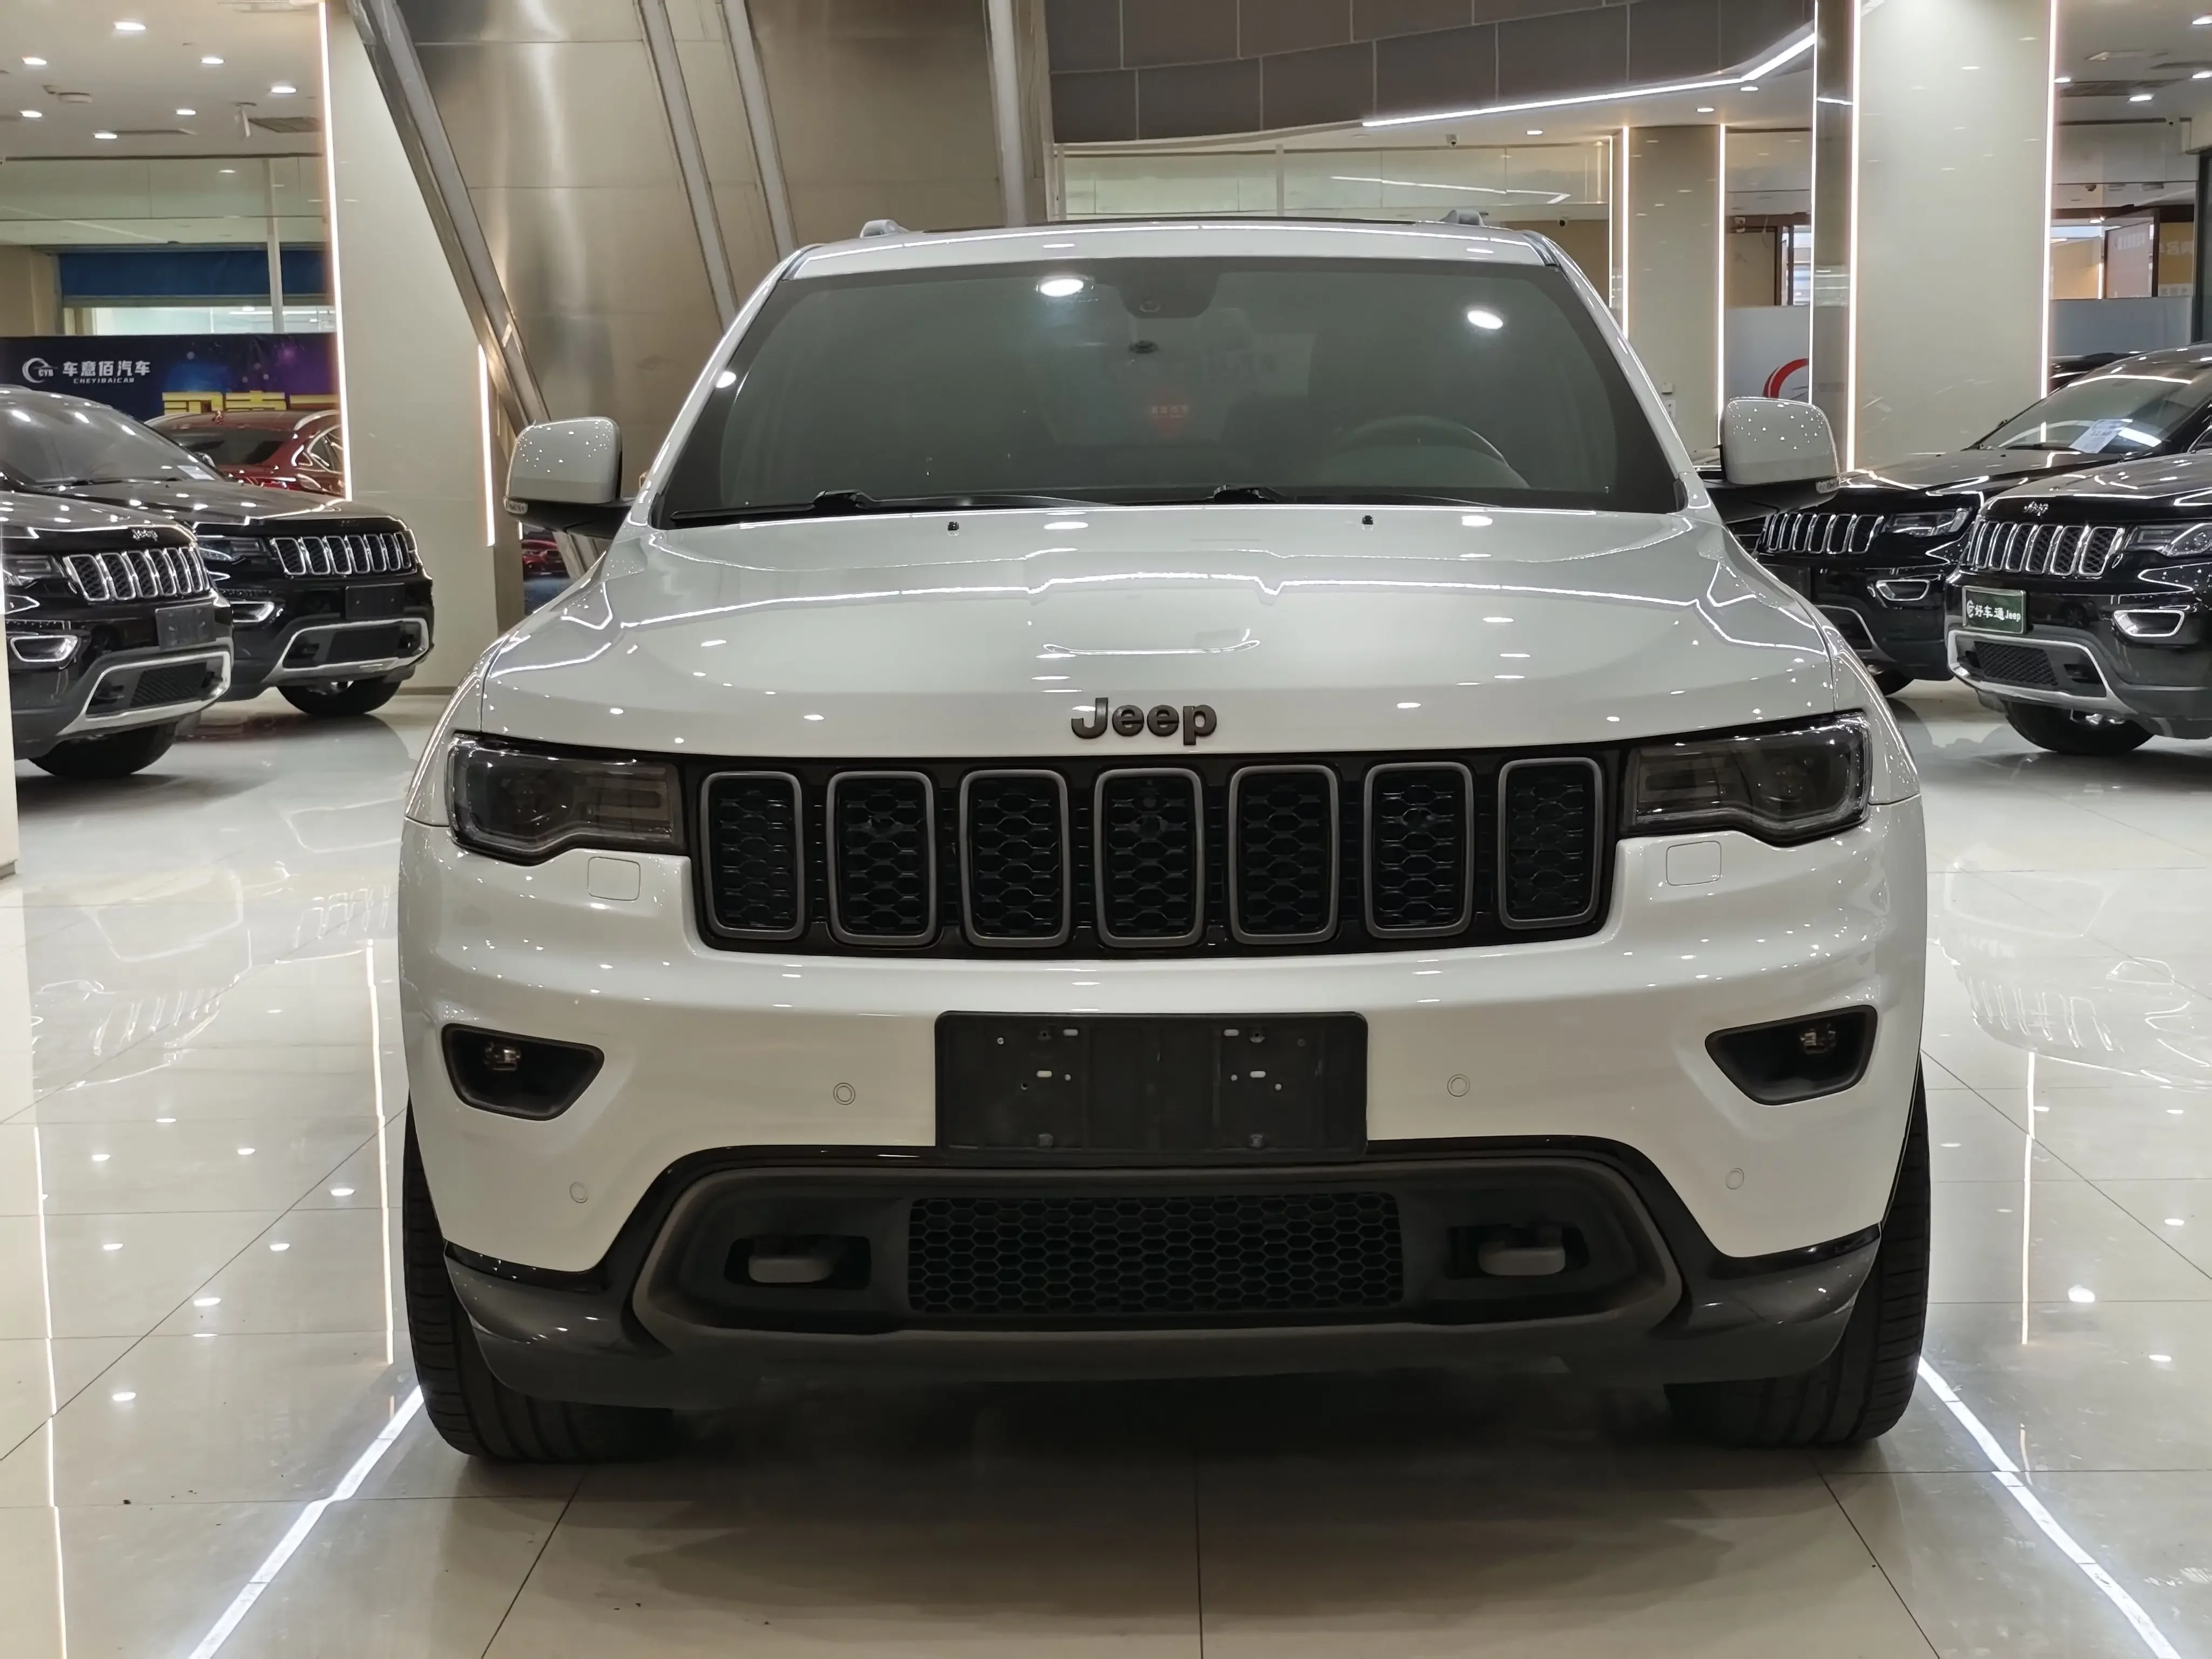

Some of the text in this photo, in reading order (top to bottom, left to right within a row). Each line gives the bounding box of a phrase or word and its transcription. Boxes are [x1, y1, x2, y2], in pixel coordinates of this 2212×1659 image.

[62, 360, 151, 377] 车意佰汽车
[1071, 697, 1218, 746] Jeep
